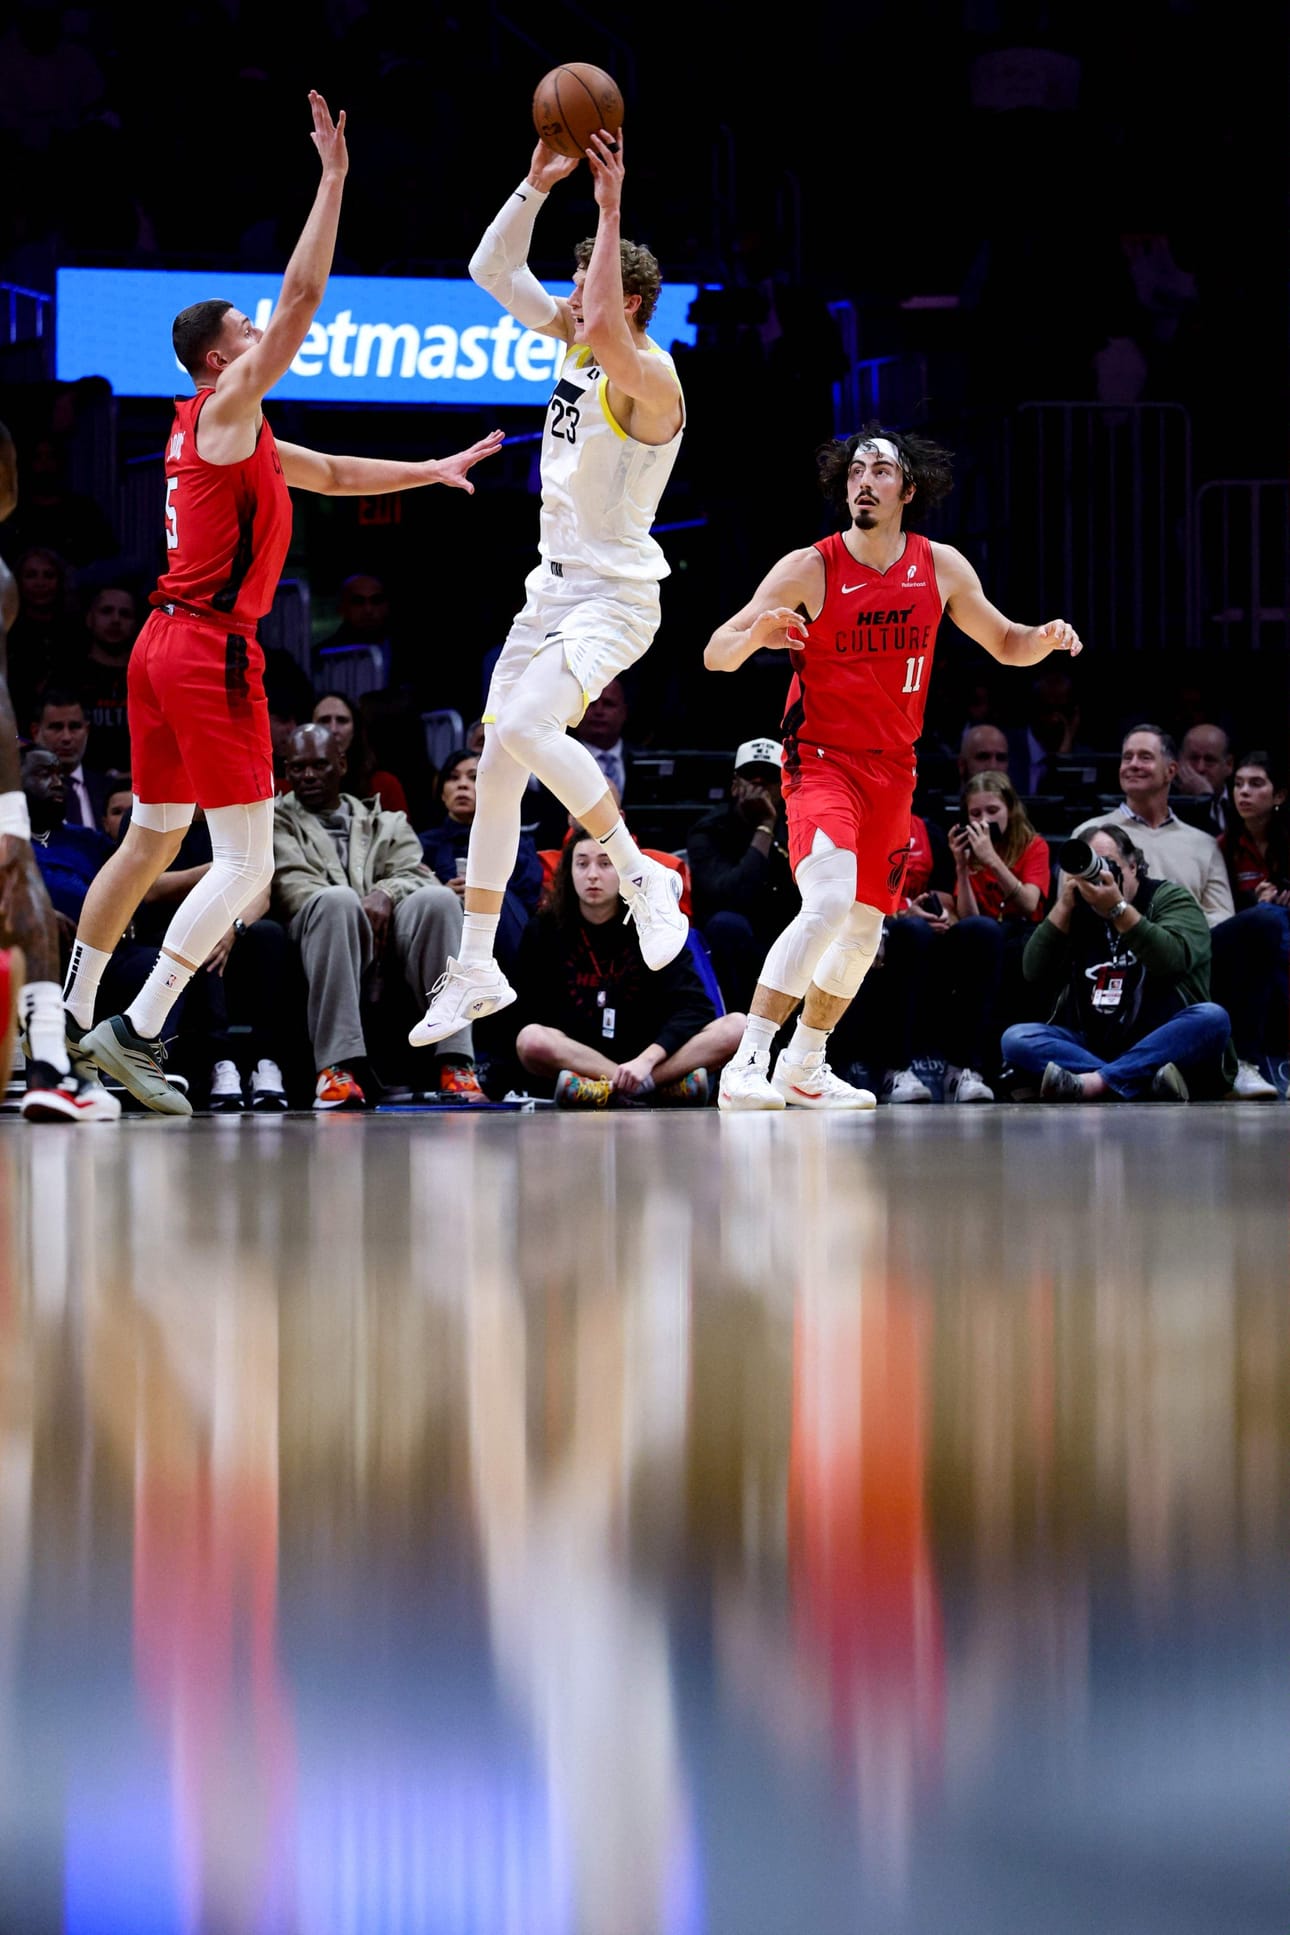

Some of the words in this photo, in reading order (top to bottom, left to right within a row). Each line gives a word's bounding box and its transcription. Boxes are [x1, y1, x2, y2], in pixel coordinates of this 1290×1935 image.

[551, 398, 580, 444] 23
[165, 477, 178, 549] 5
[857, 604, 915, 626] HEAT
[835, 625, 931, 653] CULTURE
[902, 656, 925, 693] 11
